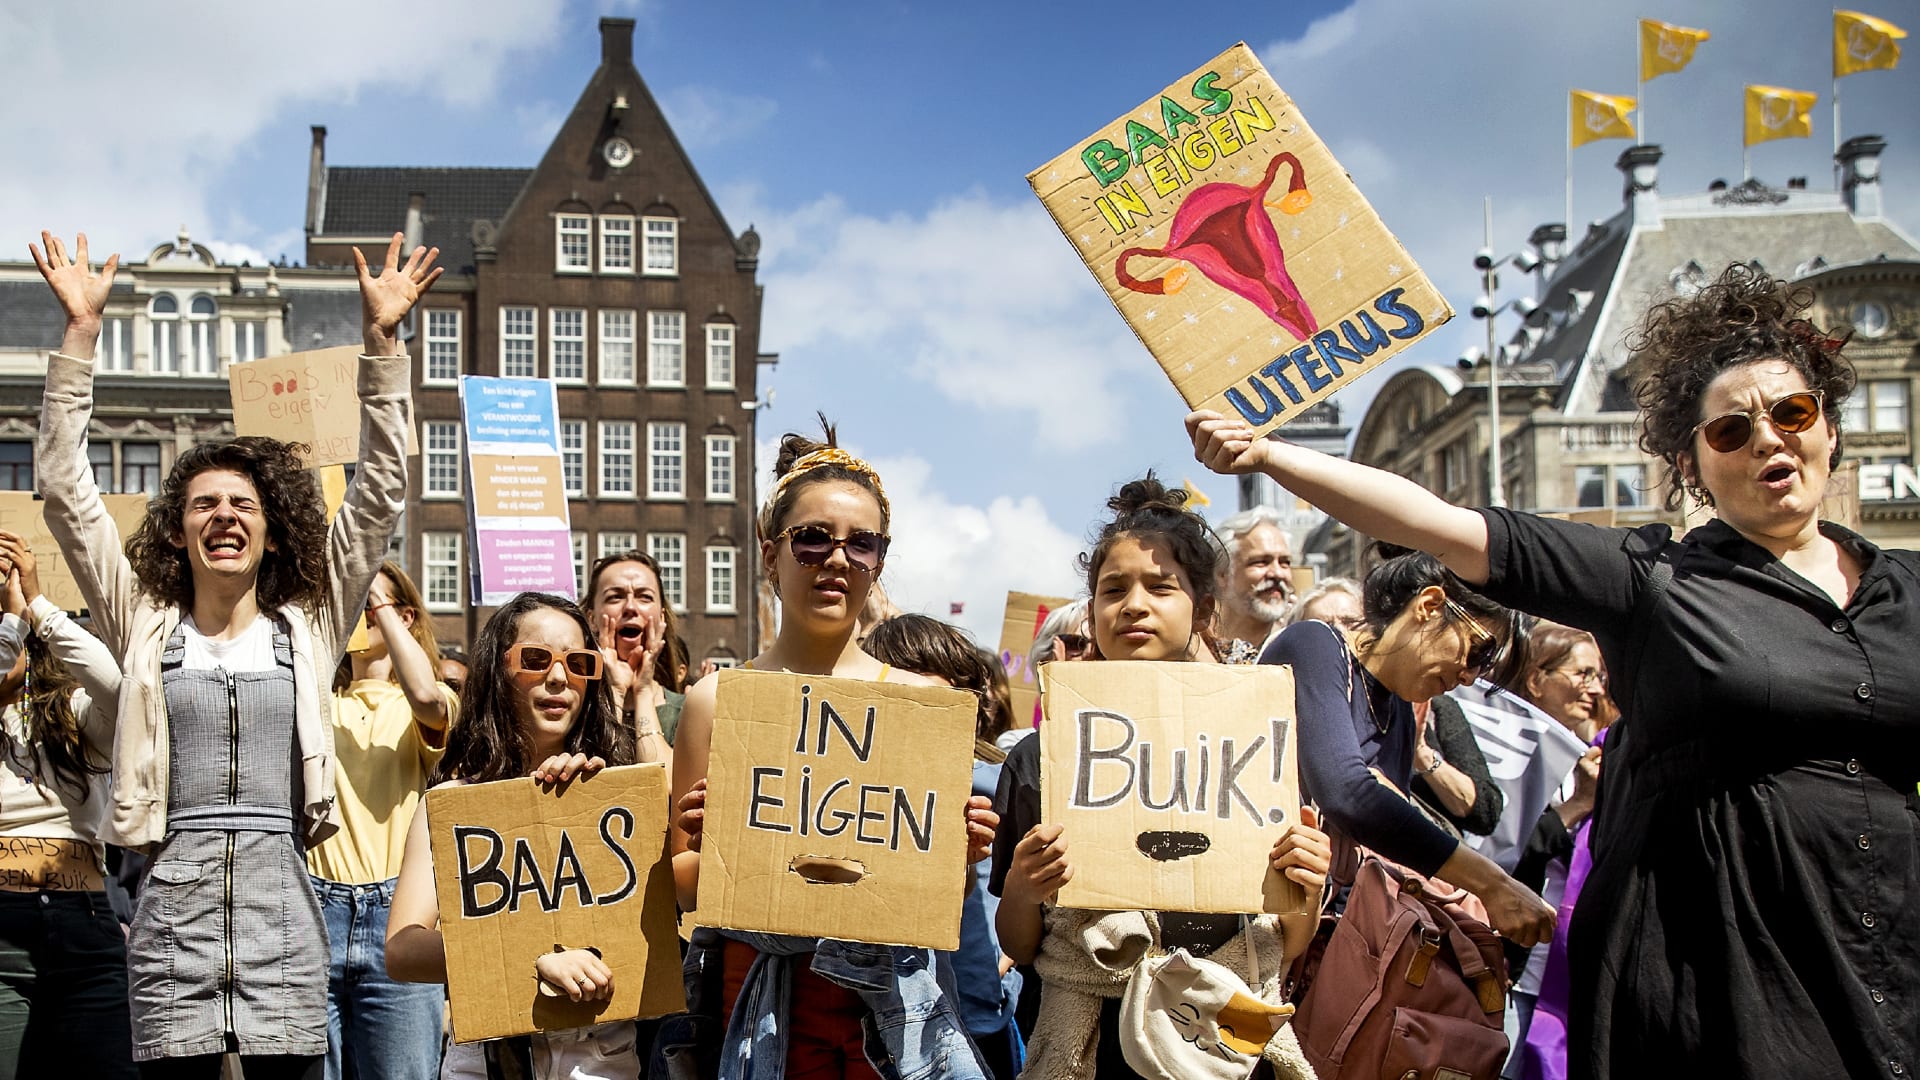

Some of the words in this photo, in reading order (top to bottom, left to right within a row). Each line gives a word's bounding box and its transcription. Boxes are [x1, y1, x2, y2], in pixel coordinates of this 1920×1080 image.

[1081, 71, 1234, 188] BAAS
[1094, 183, 1154, 236] IN
[1143, 97, 1277, 200] EIGEN
[1223, 286, 1425, 427] UTERUS
[454, 806, 637, 919] BAAS
